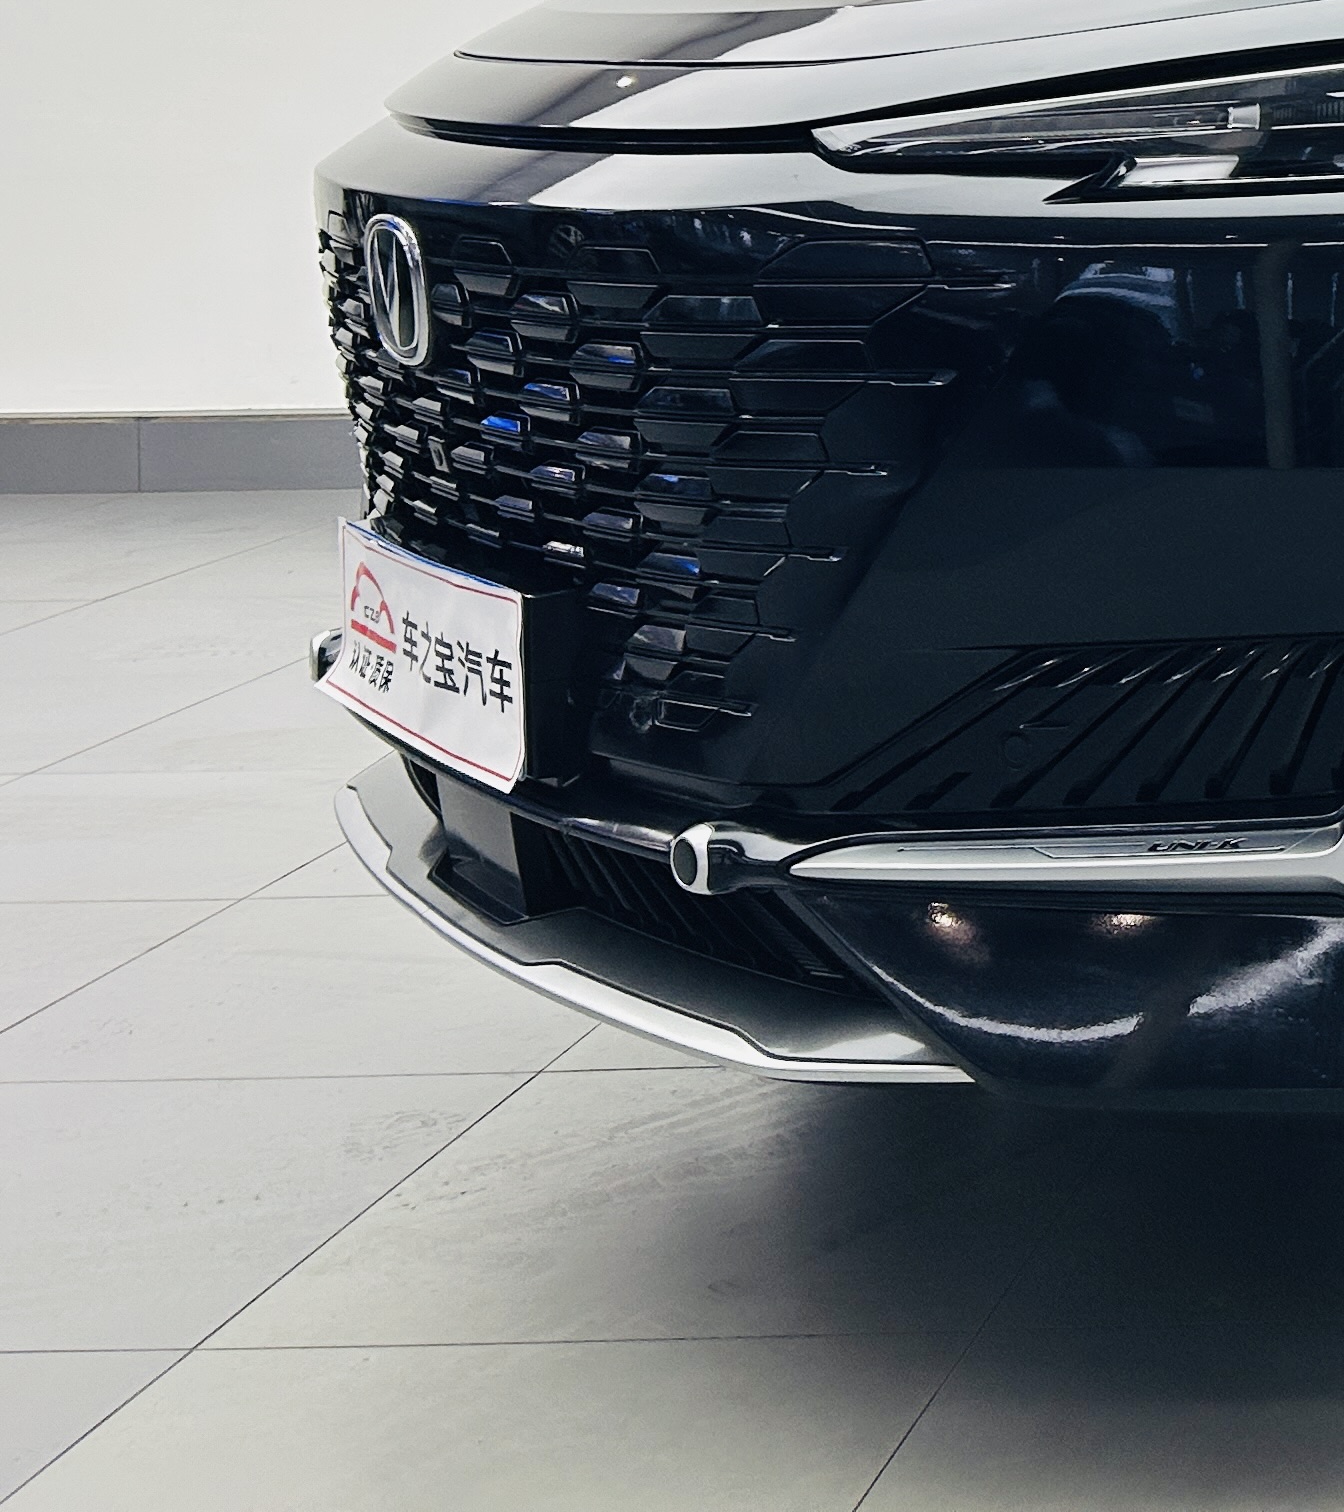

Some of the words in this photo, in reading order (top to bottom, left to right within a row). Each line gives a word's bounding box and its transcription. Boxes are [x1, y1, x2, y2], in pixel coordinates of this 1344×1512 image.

[401, 610, 514, 714] 车之宝汽车
